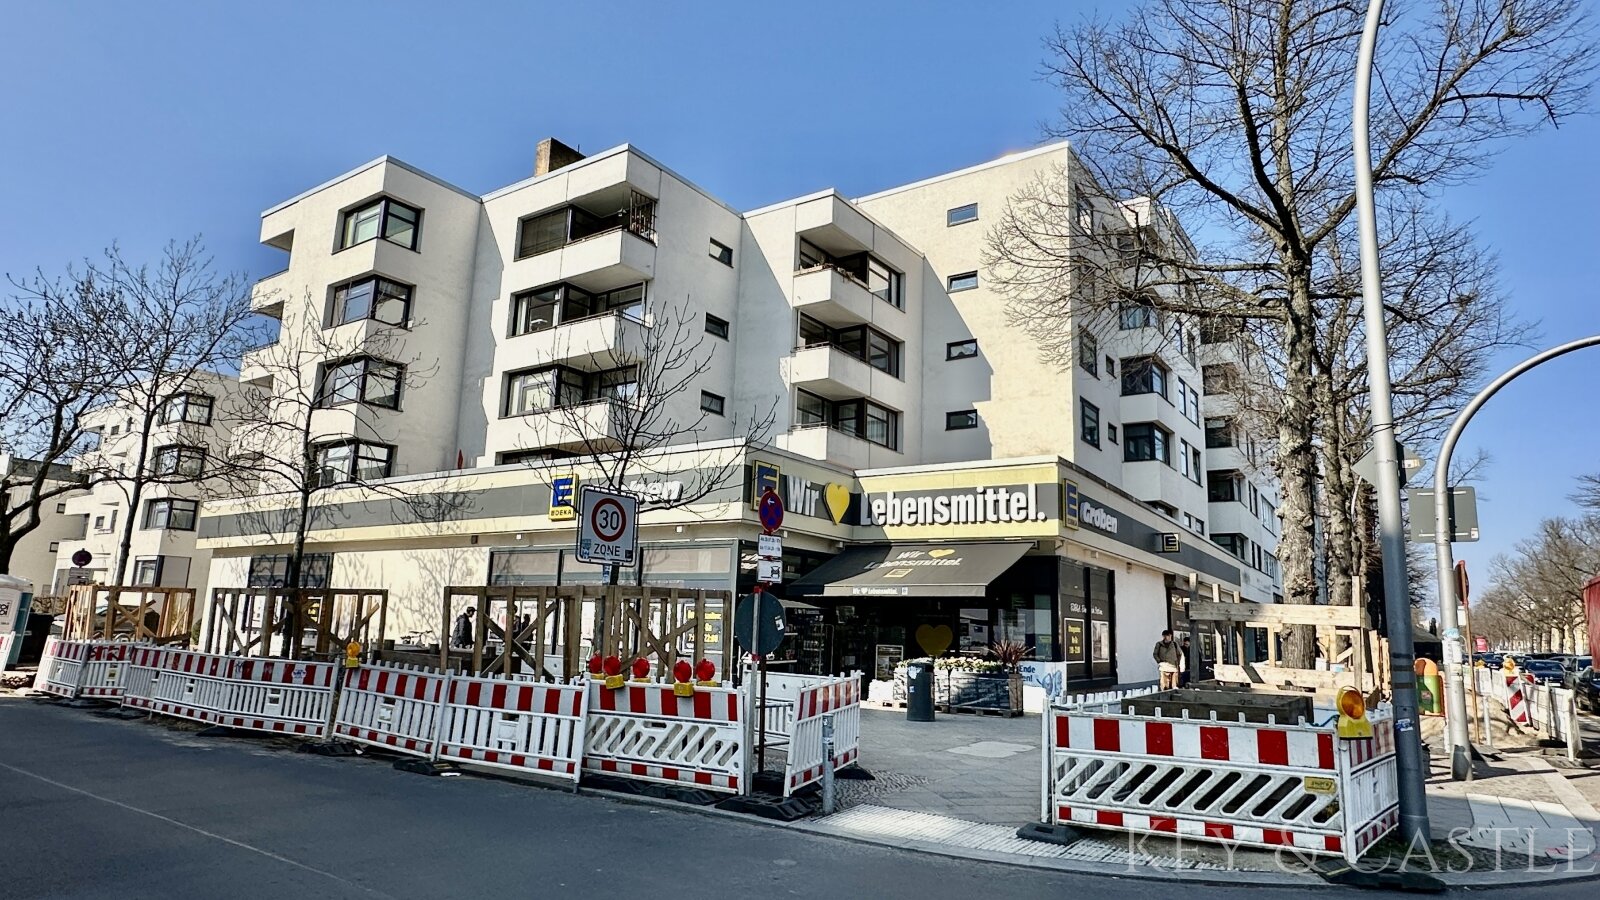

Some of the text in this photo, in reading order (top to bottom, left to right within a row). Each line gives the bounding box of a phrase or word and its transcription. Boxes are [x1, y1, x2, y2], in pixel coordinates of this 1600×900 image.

[786, 474, 819, 517] Wir
[860, 483, 1047, 526] Lebensmittel.
[599, 509, 620, 530] 30
[593, 543, 621, 557] ZONE
[896, 550, 925, 560] Wir
[1018, 664, 1036, 674] Ende
